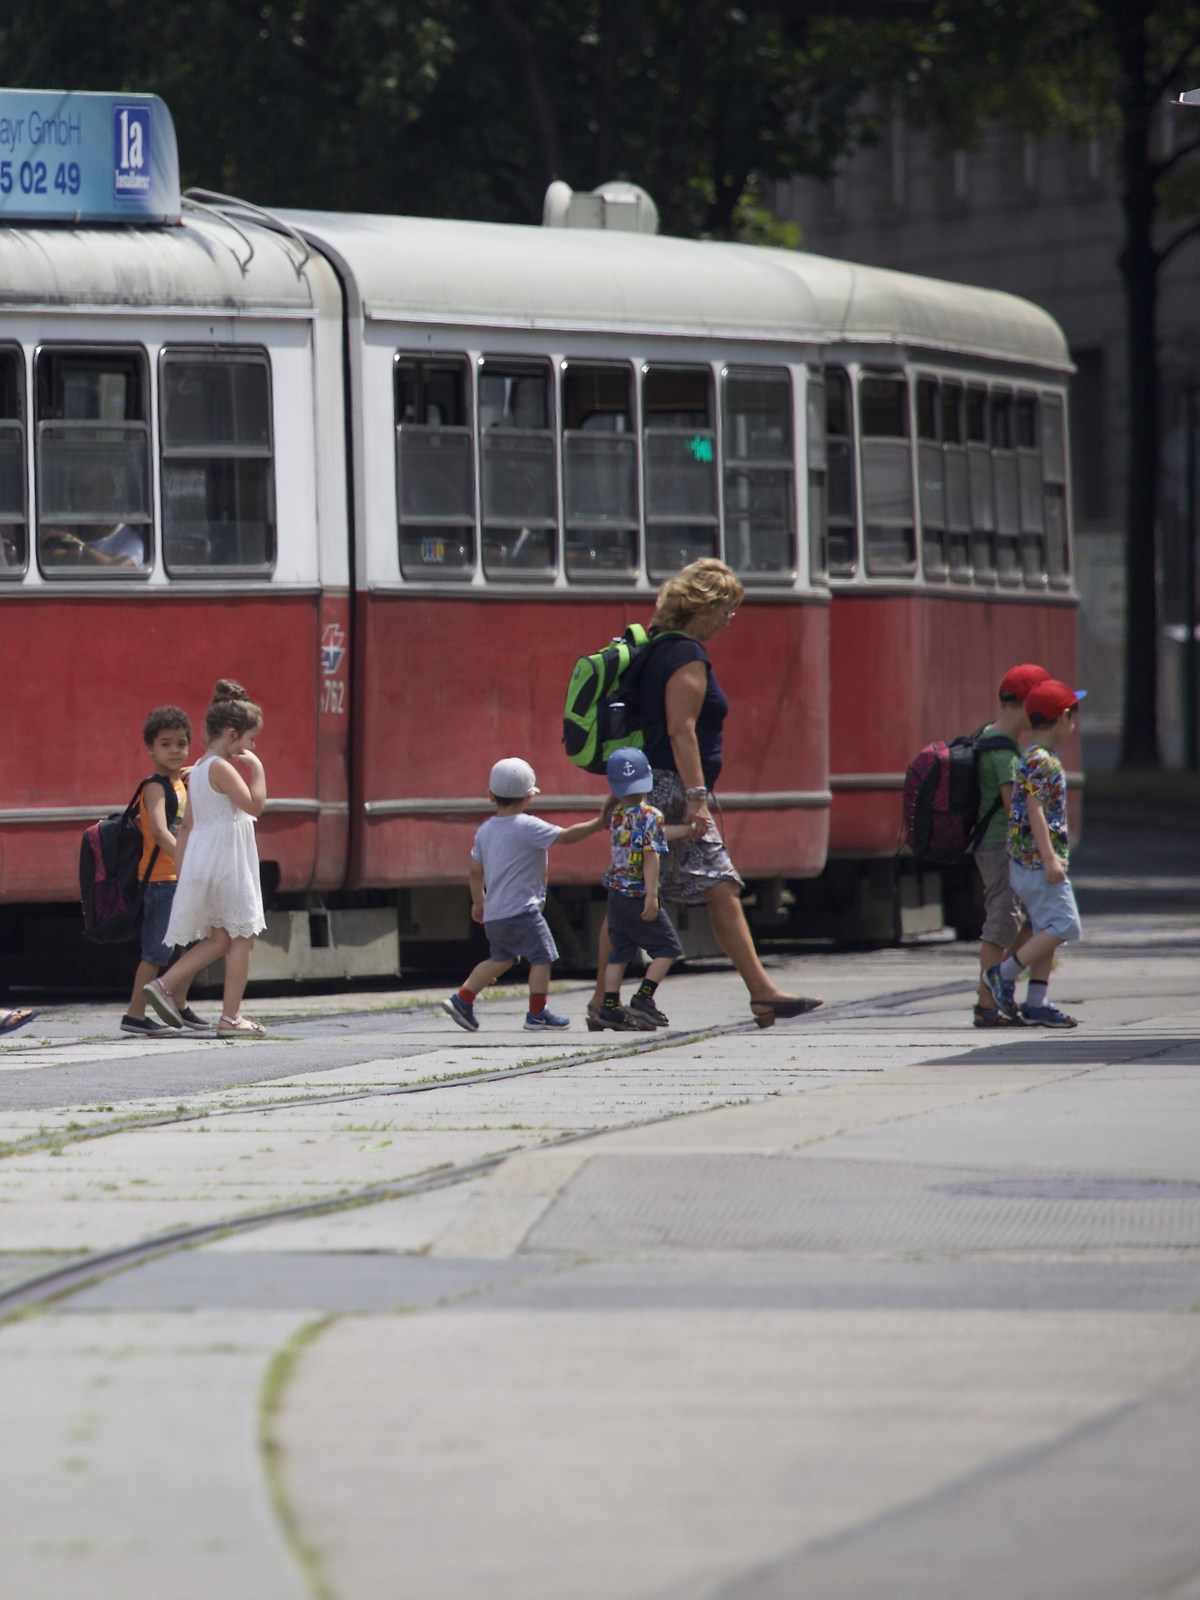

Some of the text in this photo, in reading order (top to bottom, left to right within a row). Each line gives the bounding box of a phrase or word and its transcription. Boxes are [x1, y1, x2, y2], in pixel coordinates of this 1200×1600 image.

[28, 109, 82, 146] GmbH
[120, 109, 145, 170] 1a
[19, 160, 48, 196] 02
[54, 161, 82, 197] 49
